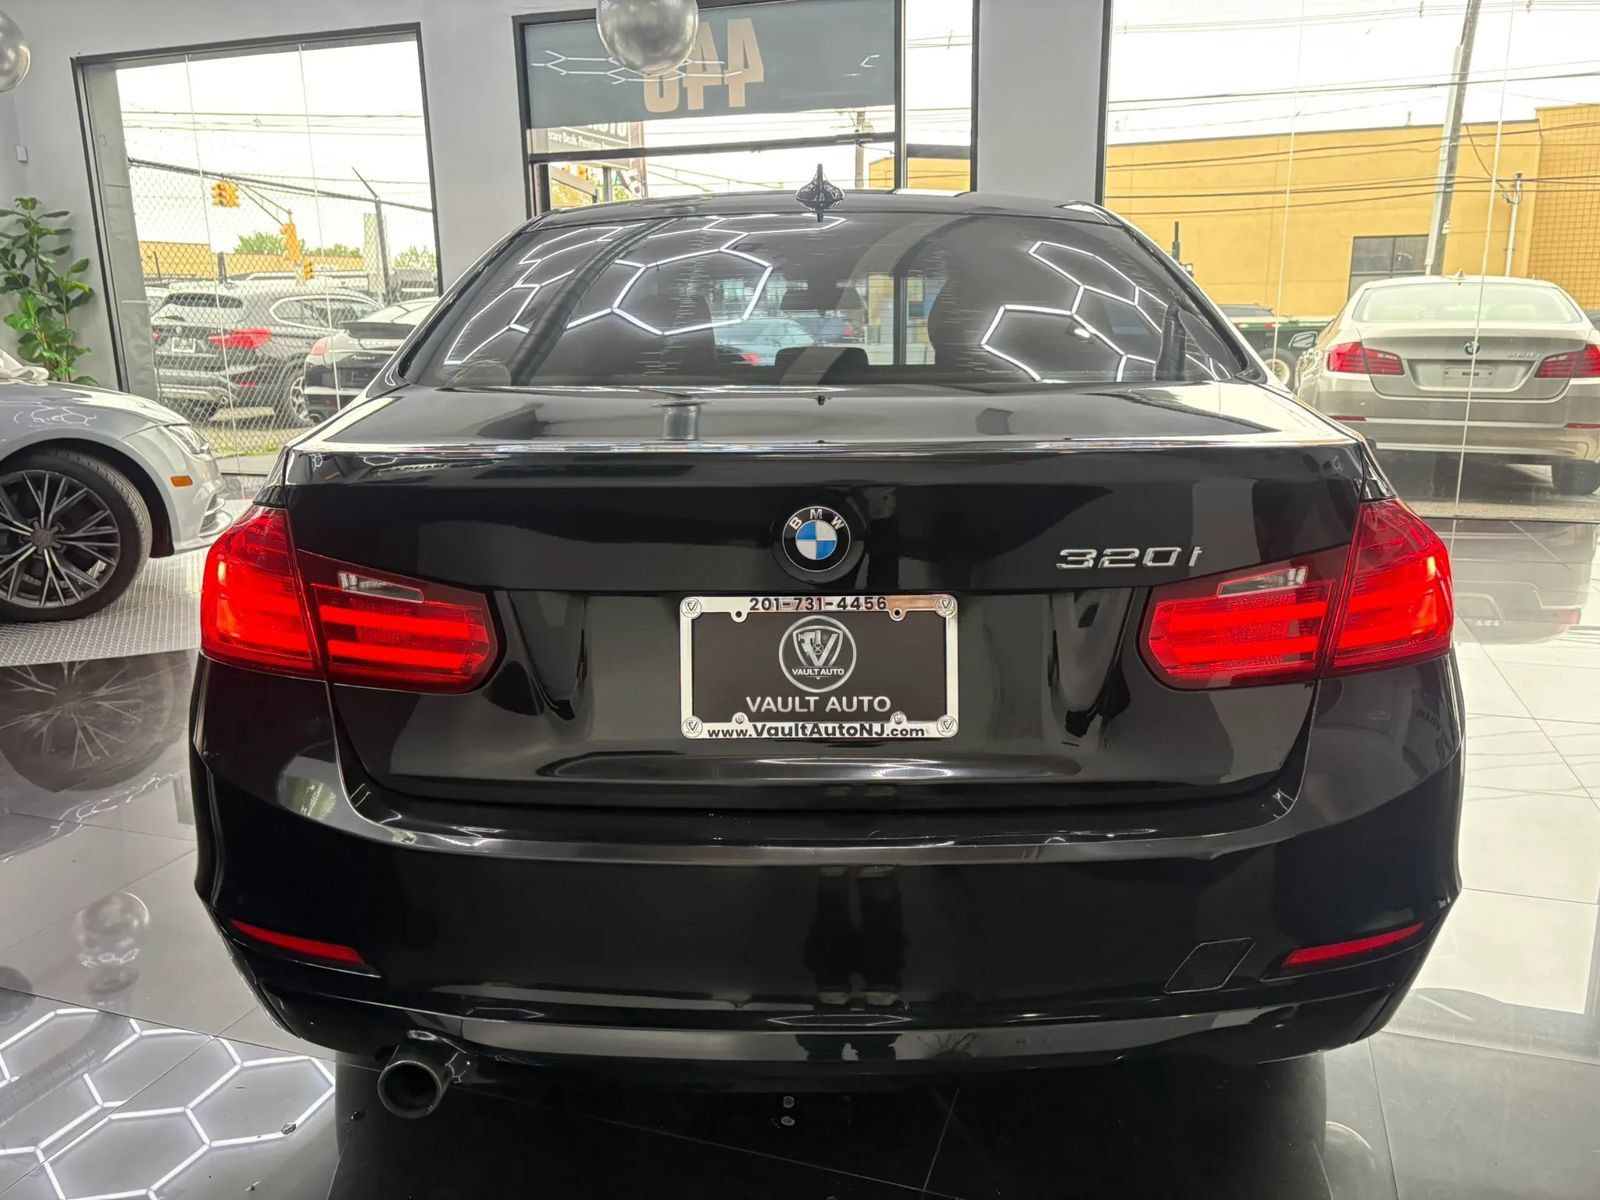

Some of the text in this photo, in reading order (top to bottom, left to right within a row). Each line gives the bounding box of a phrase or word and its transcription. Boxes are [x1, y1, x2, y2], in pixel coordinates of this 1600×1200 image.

[789, 508, 844, 530] BMW
[1056, 546, 1203, 569] 320i
[749, 596, 887, 611] 201-731-4456
[792, 668, 845, 676] VAULT AUTO
[746, 696, 891, 713] VAULT AUTO
[707, 723, 925, 738] www.VaultAutoNJ.com
